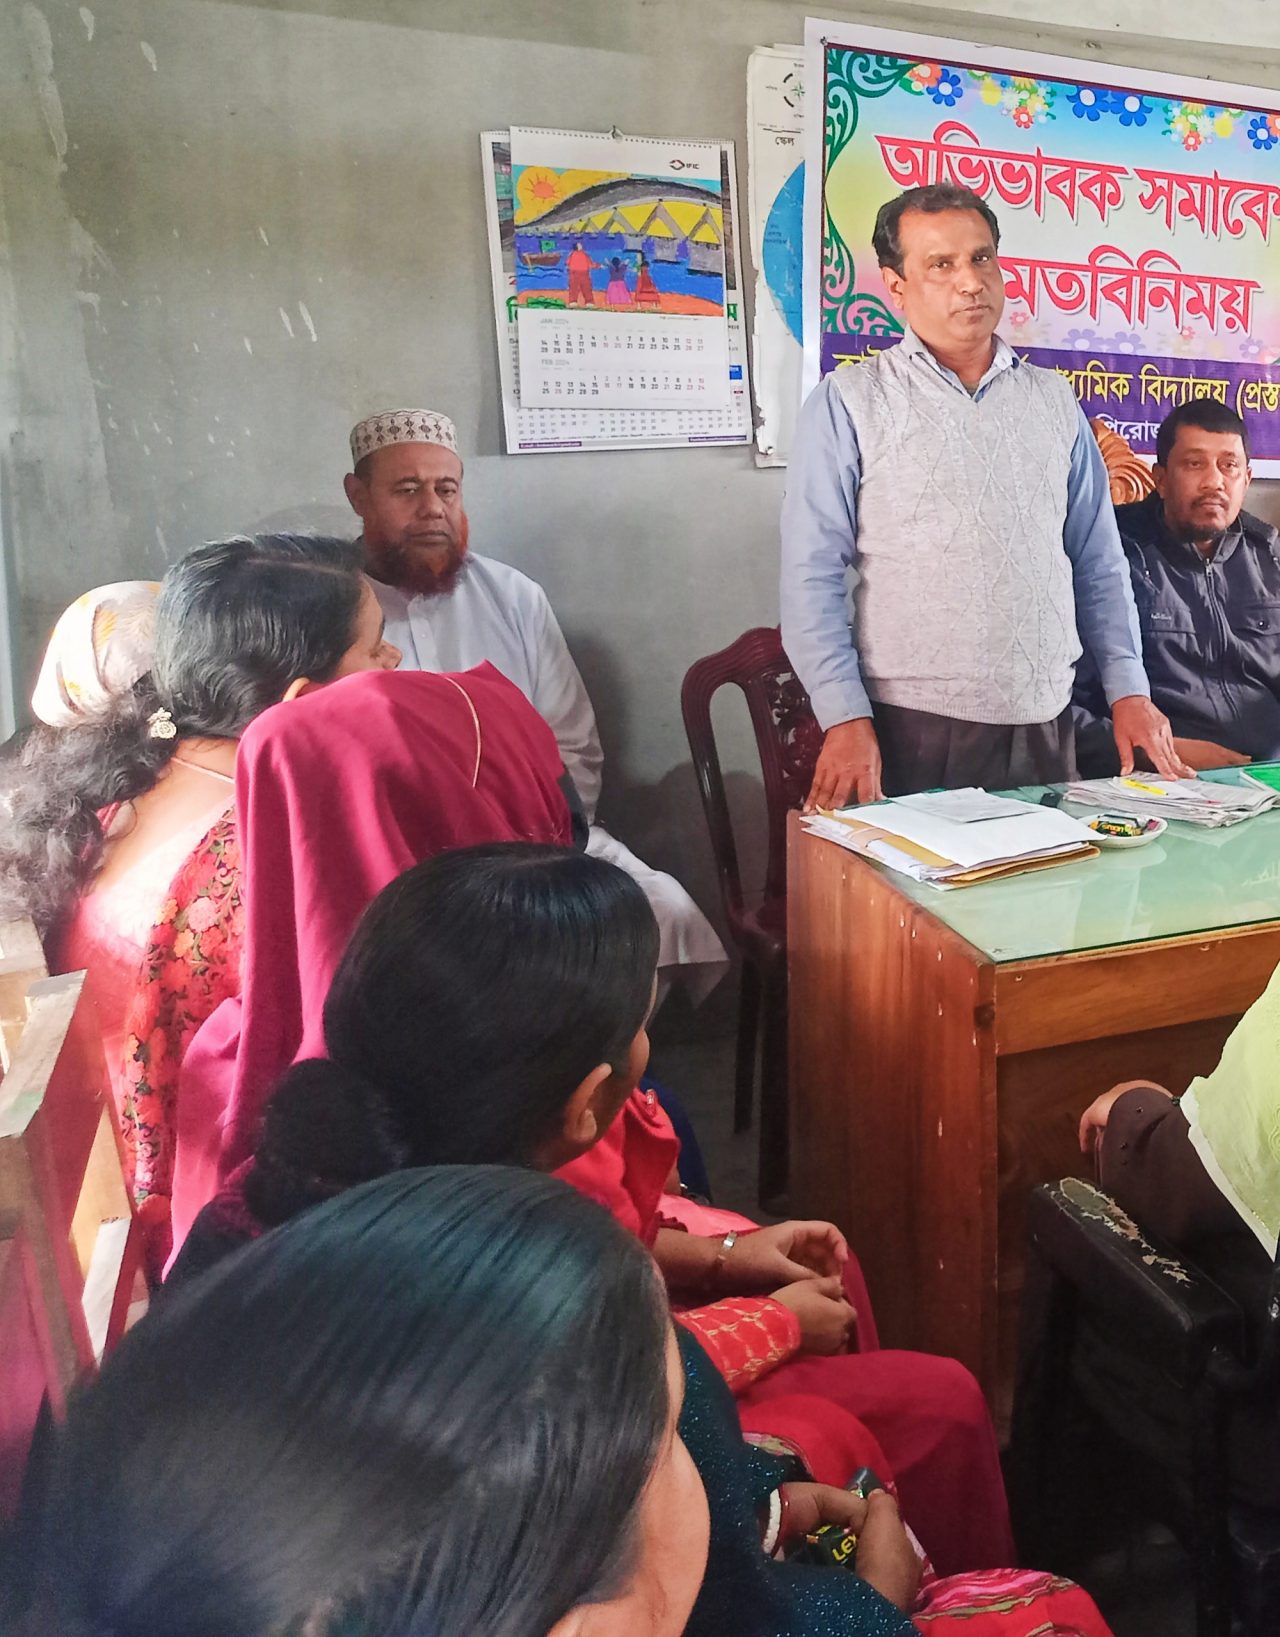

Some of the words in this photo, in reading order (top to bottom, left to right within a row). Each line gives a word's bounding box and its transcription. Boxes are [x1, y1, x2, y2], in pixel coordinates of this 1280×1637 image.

[874, 121, 1129, 223] অভিভাবক
[998, 245, 1261, 334] মতবিনিময়
[1139, 364, 1230, 407] বিদ্যালয়
[832, 1534, 857, 1561] LEX
